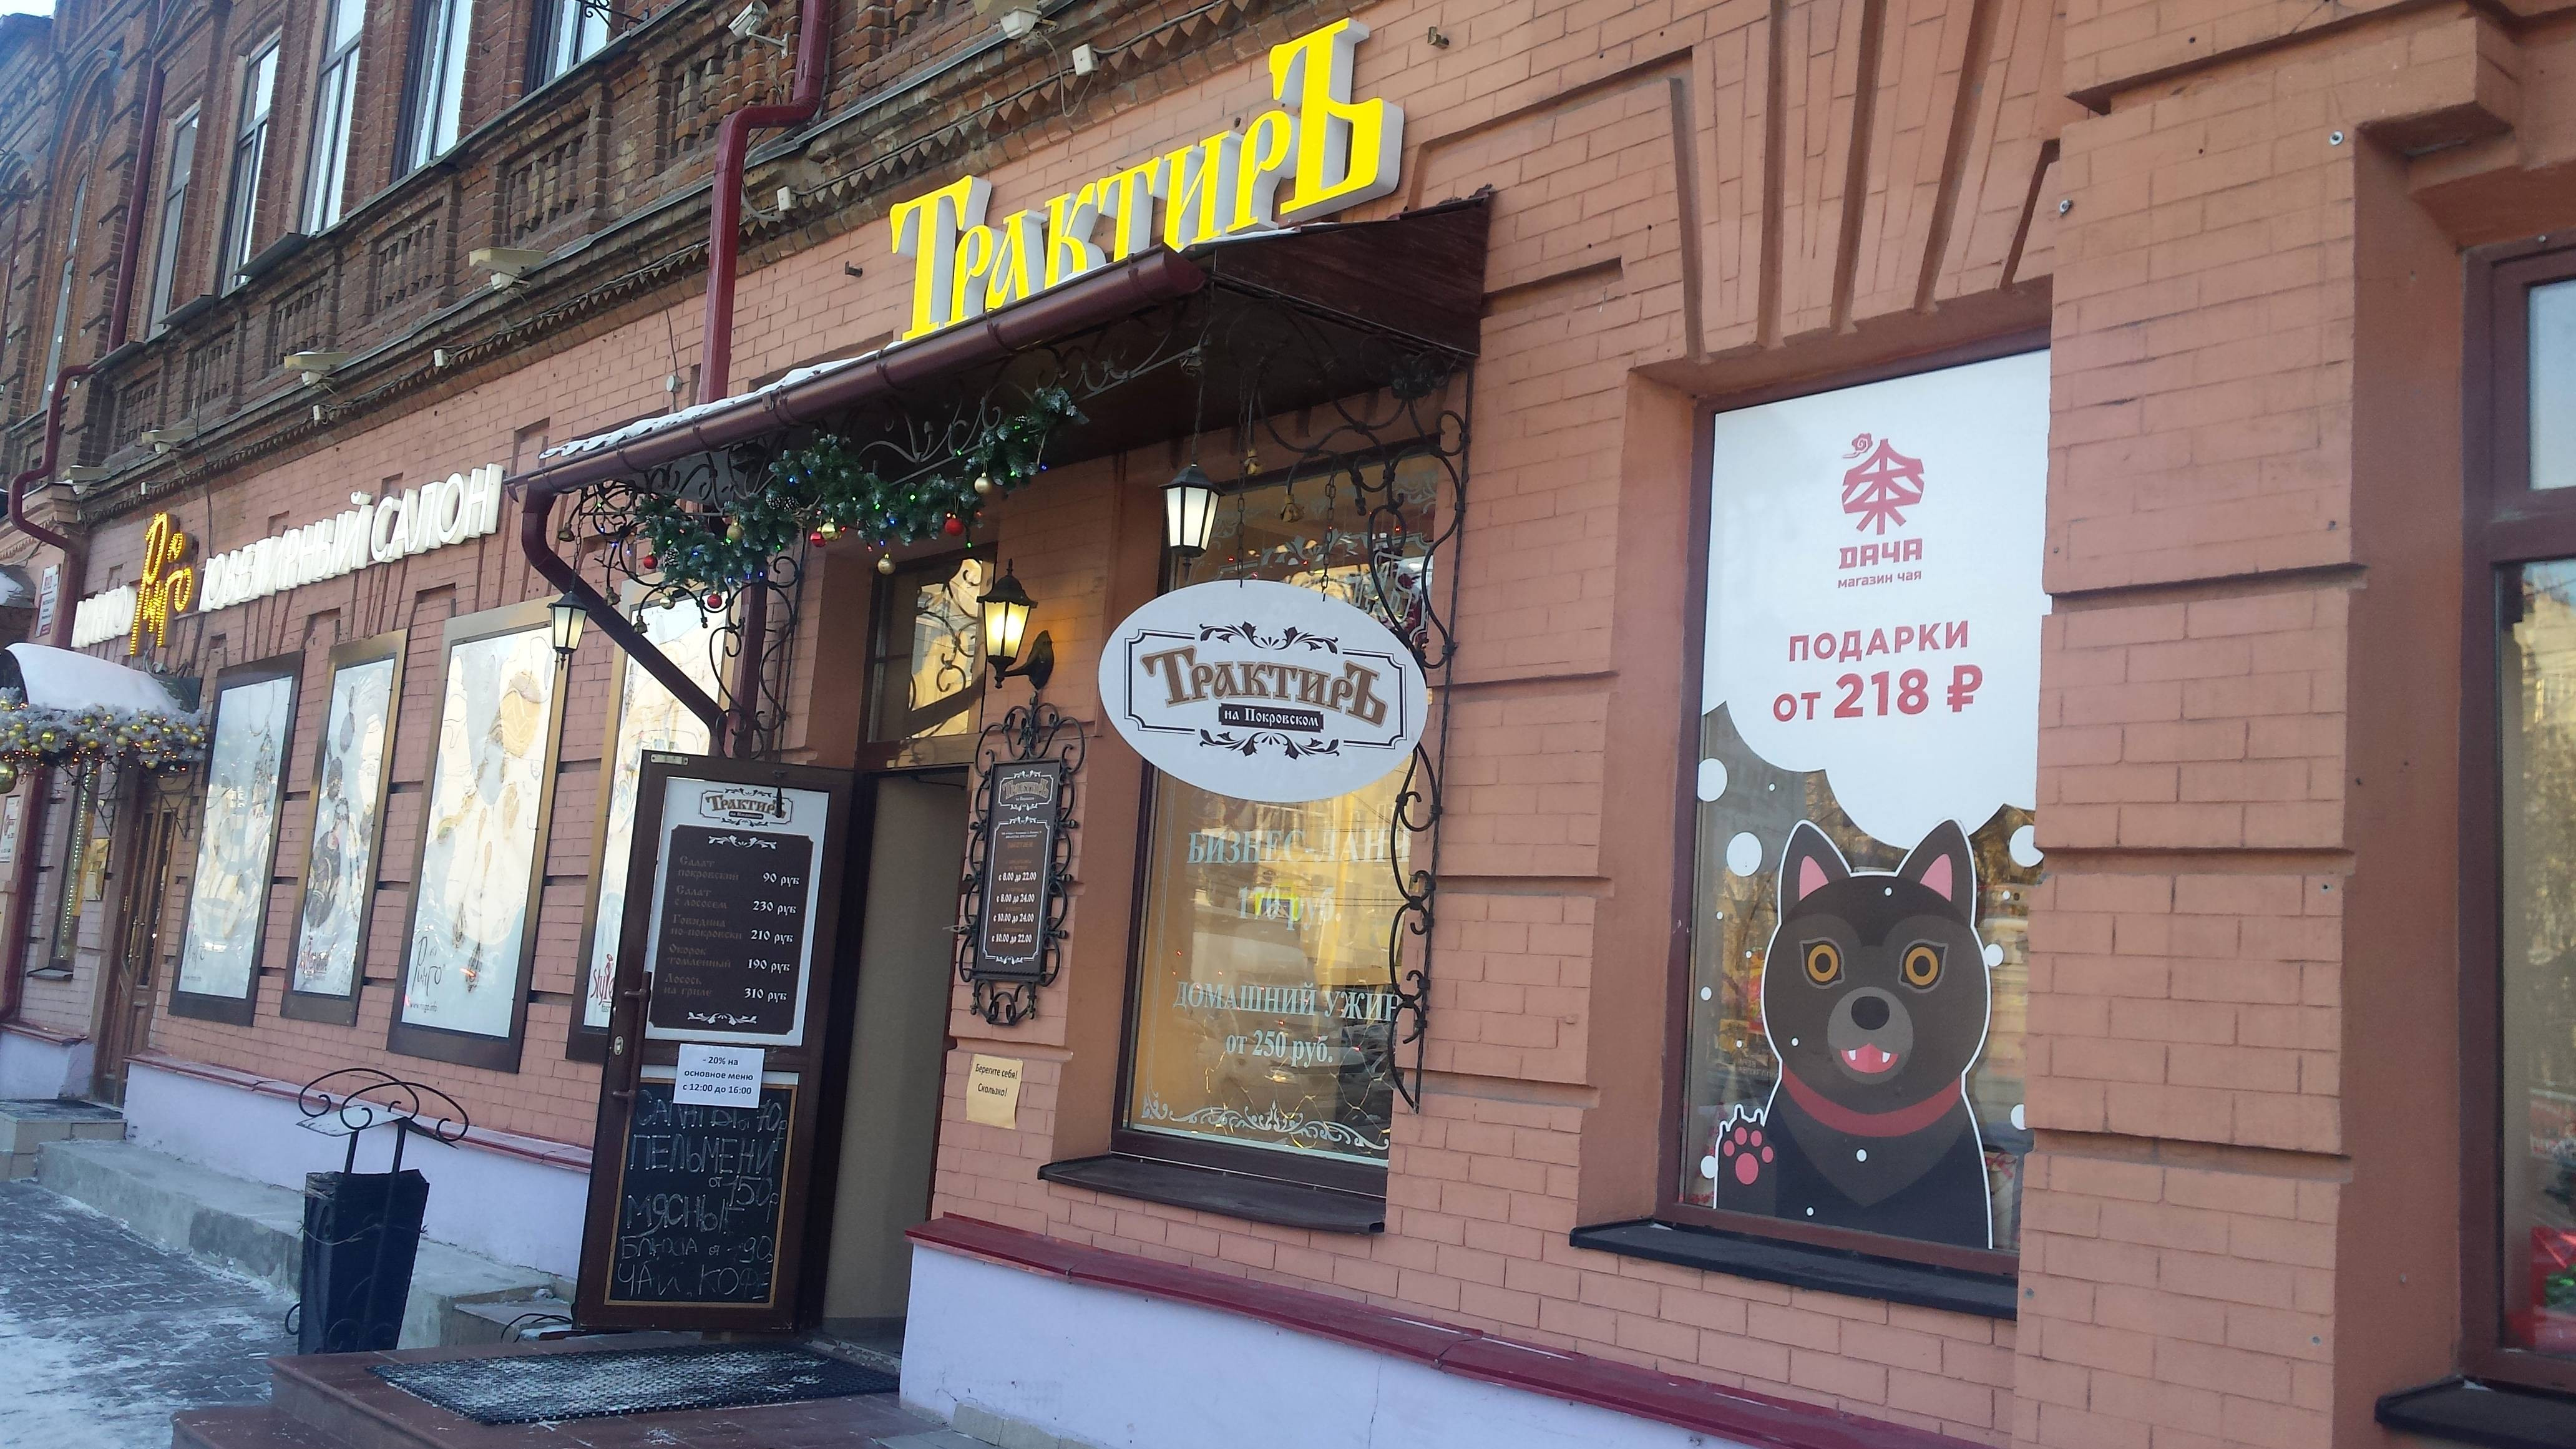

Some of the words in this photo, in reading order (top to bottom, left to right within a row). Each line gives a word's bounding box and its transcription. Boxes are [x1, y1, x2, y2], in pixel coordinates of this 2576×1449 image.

[199, 490, 374, 612] ЮВЕЛИРНЫЙ
[371, 463, 504, 562] САЛОН
[1839, 538, 1923, 569] ДАЧА
[1838, 573, 1893, 588] магазин
[1897, 570, 1922, 582] чая
[1789, 620, 1968, 663] ПОДАРКИ
[1834, 668, 1929, 718] 218
[1224, 709, 1239, 720] на
[1244, 708, 1319, 727] Покровском
[763, 872, 776, 883] 90
[781, 876, 799, 887] руб
[1022, 872, 1037, 881] 22.00
[1020, 894, 1035, 902] 24.00
[753, 900, 774, 912] 230
[778, 904, 796, 915] руб
[998, 914, 1012, 922] 10.00
[1020, 913, 1035, 922] 24.00
[751, 930, 771, 940] 210
[774, 933, 793, 945] руб
[995, 934, 1009, 942] 10.00
[1017, 934, 1032, 942] 22.00
[748, 959, 767, 970] 190
[771, 963, 790, 973] руб
[744, 988, 763, 999] 310
[768, 992, 787, 1003] руб
[1173, 982, 1317, 1016] ДОМАШНИЙ
[1226, 1034, 1247, 1055] от
[1252, 1030, 1287, 1058] 250
[1291, 1035, 1333, 1068] руб.
[684, 1070, 726, 1080] основное
[728, 1072, 753, 1081] меню
[975, 1063, 1000, 1076] Берегите
[1002, 1069, 1018, 1080] себя!
[689, 1083, 713, 1093] 12:00
[714, 1086, 726, 1095] до
[728, 1086, 752, 1095] 16:00
[978, 1083, 1008, 1097] Скользко!
[629, 1133, 776, 1176] ПЕЛЬМЕНИ
[708, 1176, 723, 1188] от
